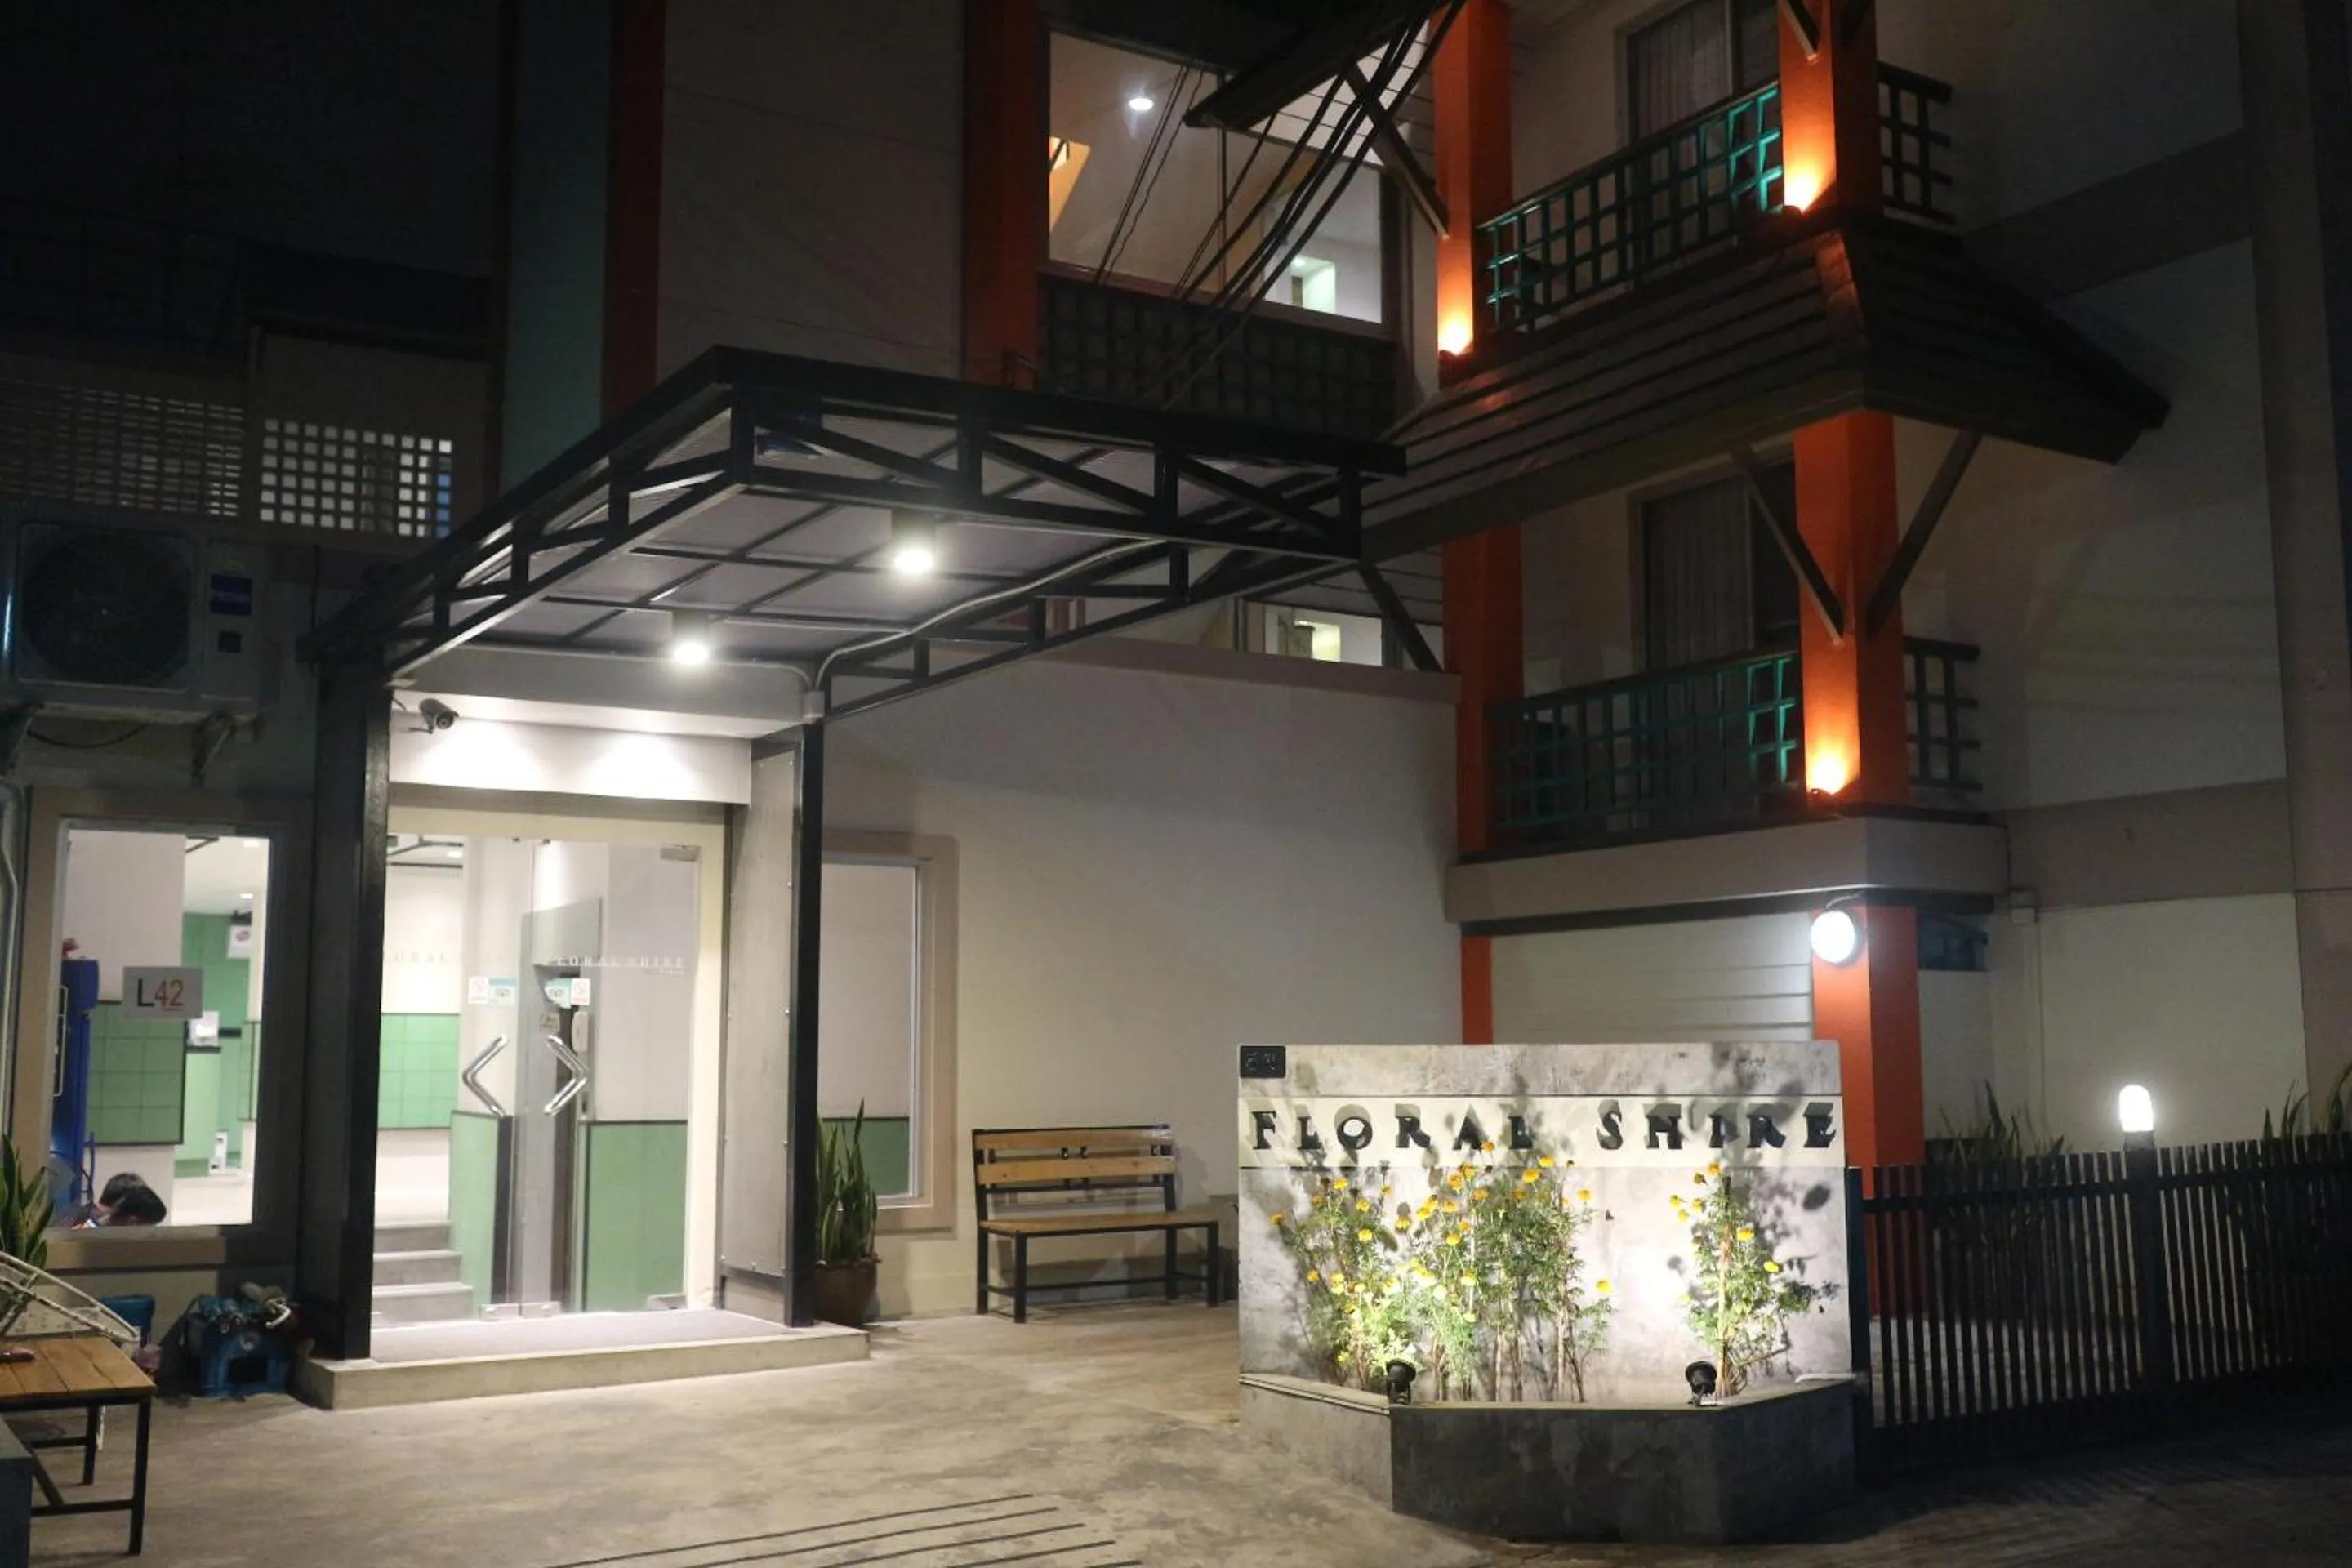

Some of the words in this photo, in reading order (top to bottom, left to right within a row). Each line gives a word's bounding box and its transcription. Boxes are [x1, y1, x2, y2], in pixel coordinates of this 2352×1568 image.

[136, 978, 185, 1008] L42
[1251, 1110, 1535, 1150] FLORAL
[1595, 1110, 1838, 1150] SHIRE
